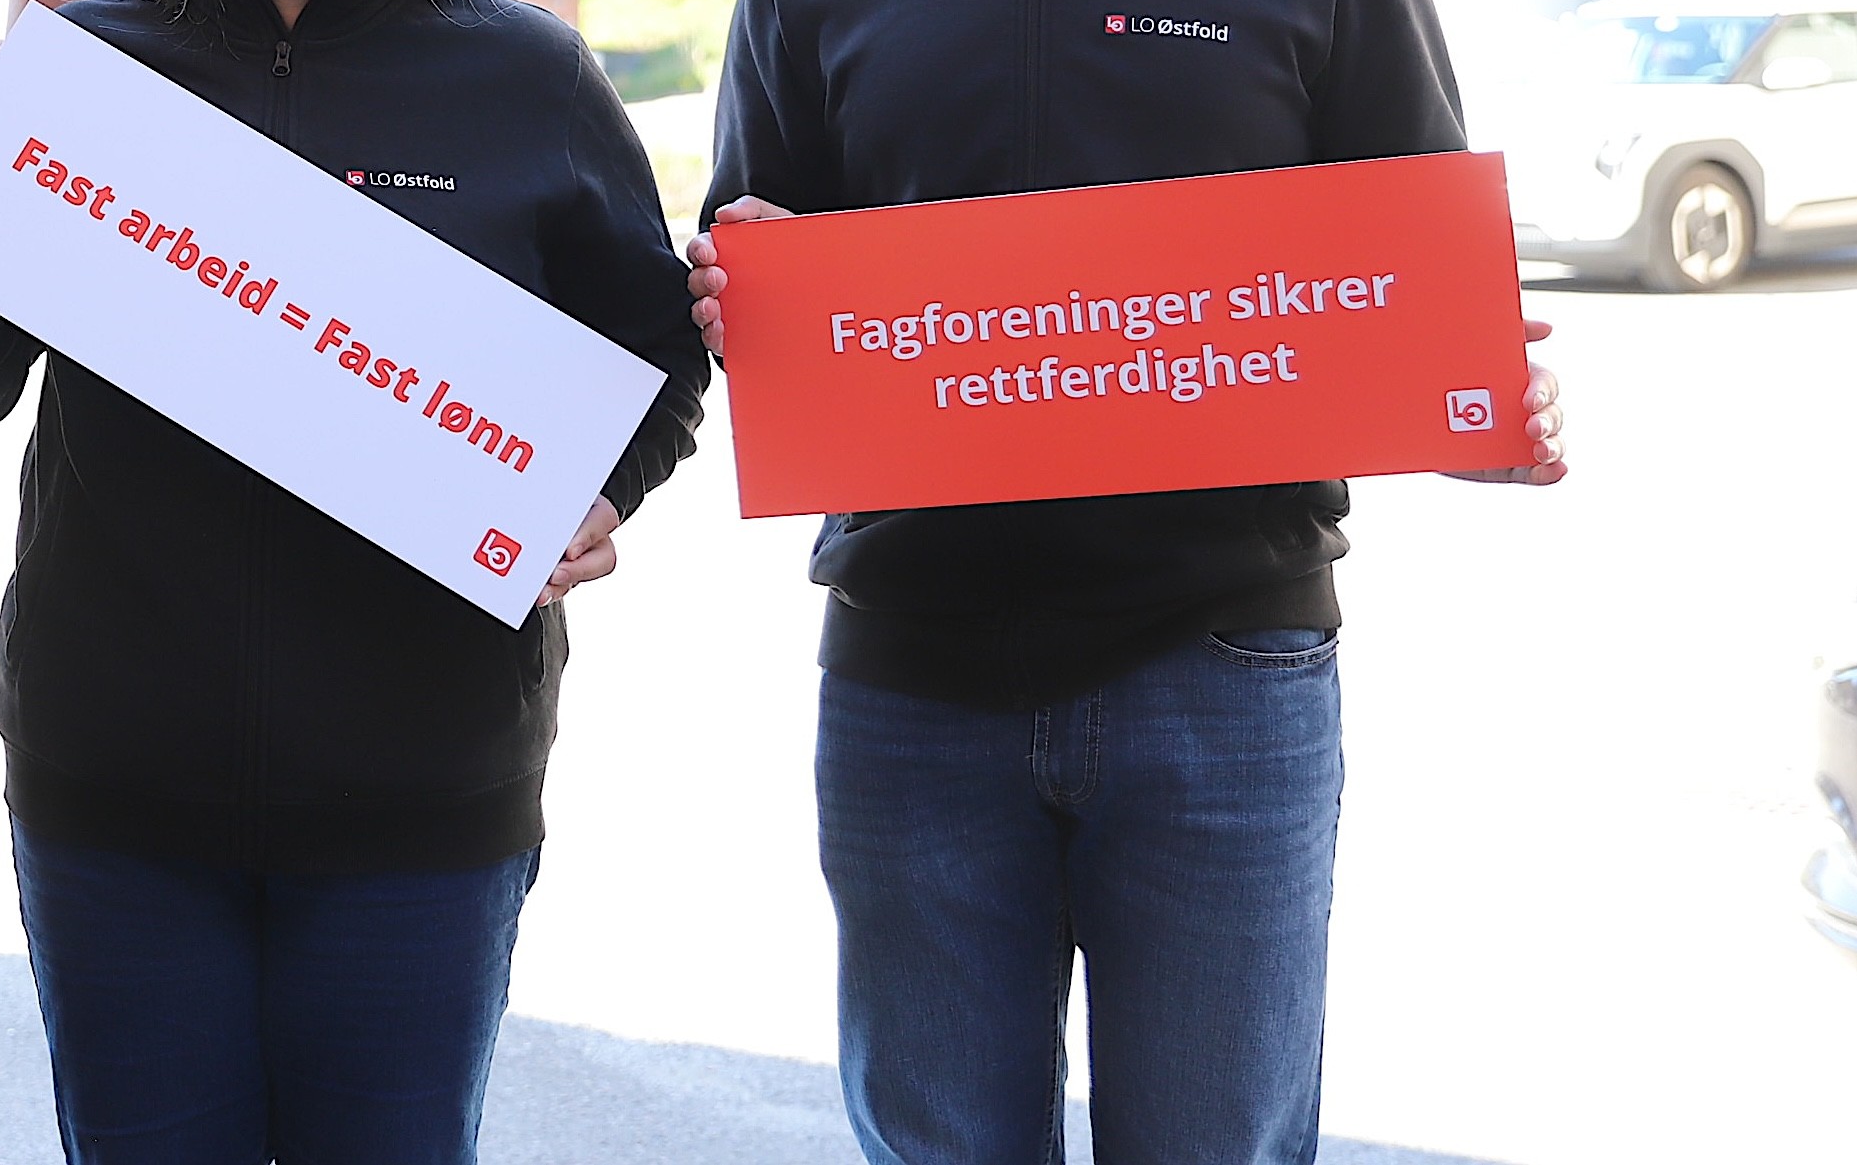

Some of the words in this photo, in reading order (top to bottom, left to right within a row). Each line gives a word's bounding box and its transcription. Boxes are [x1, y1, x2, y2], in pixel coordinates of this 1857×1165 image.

[1131, 17, 1155, 33] LO
[1158, 19, 1229, 42] Østfold
[369, 172, 390, 186] LO
[393, 173, 455, 191] Østfold
[11, 136, 116, 221] Fast
[118, 204, 279, 316] arbeid
[279, 298, 312, 330] =
[313, 317, 421, 403] Fast
[422, 380, 536, 474] lønn
[829, 284, 1213, 358] Fagforeninger
[1228, 270, 1396, 322] sikrer
[933, 341, 1299, 408] rettferdighet
